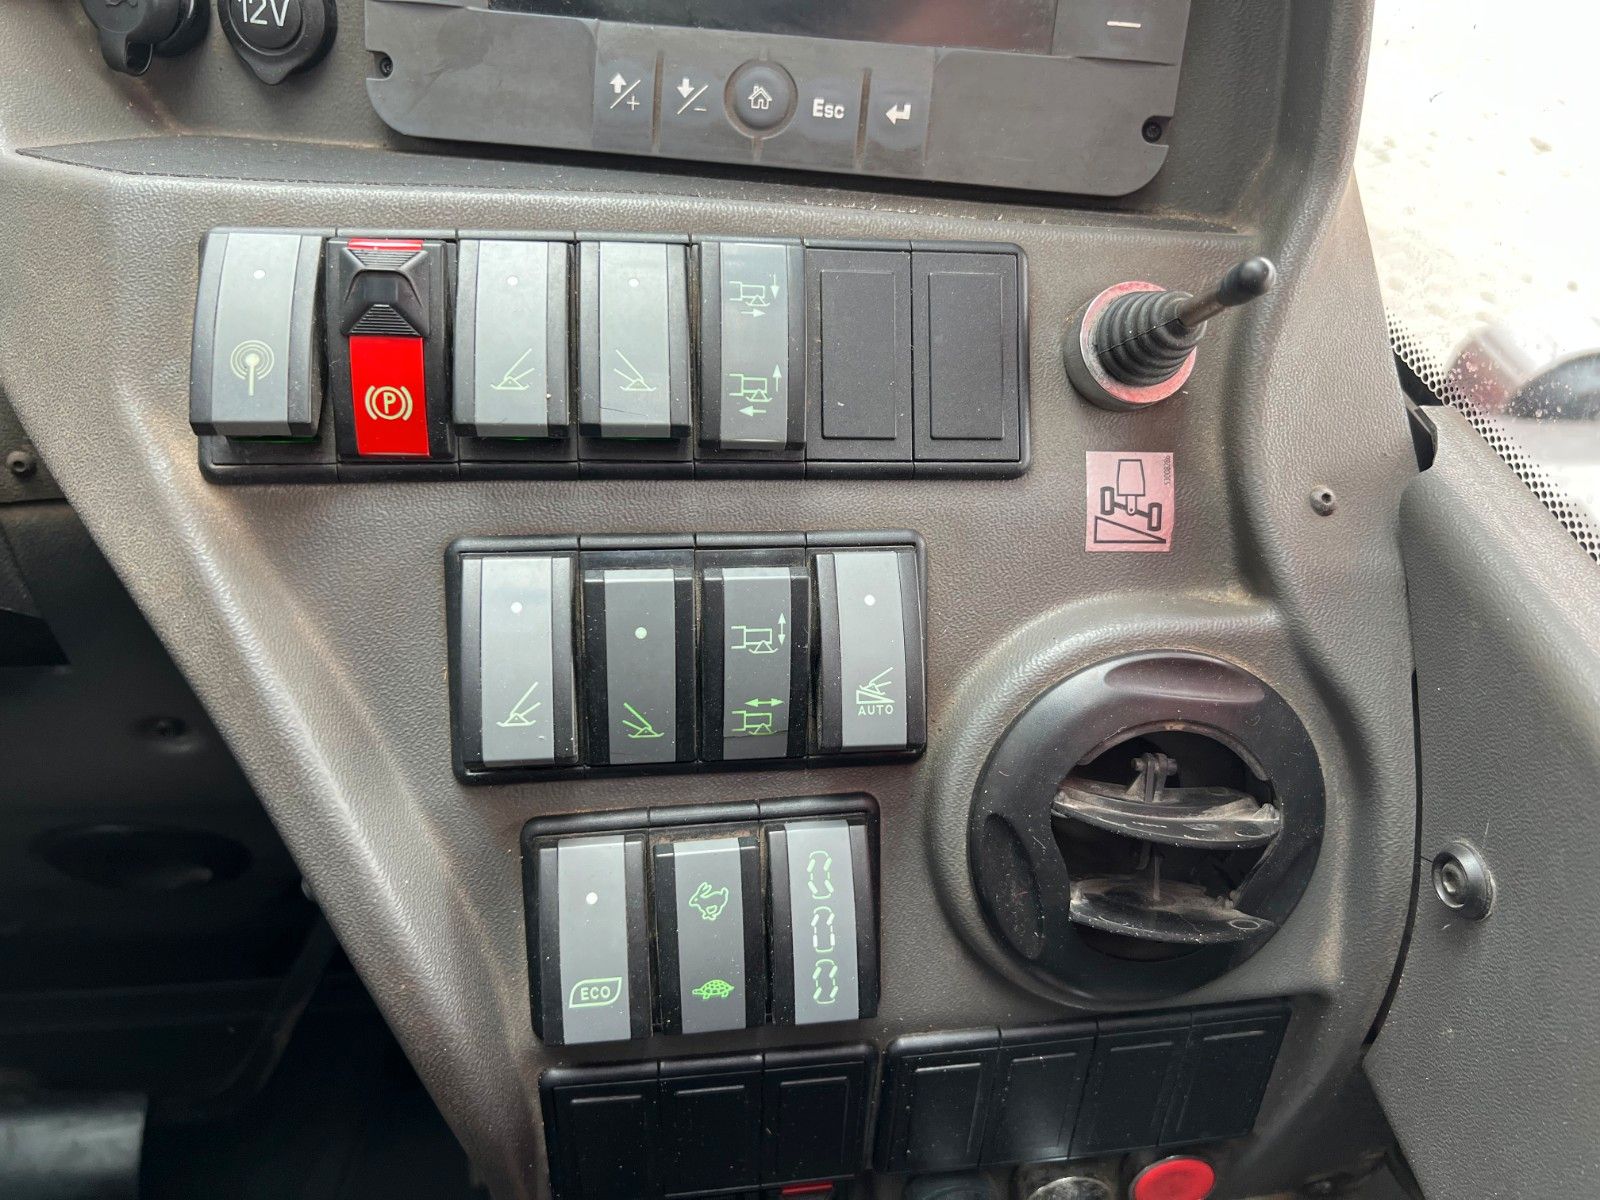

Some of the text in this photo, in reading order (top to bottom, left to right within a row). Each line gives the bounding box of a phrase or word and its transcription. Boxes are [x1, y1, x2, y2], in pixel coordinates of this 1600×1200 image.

[238, 0, 290, 27] 12V
[812, 98, 845, 119] Esc
[383, 391, 397, 414] P
[858, 704, 894, 716] AUTO
[580, 985, 611, 1001] ECO
